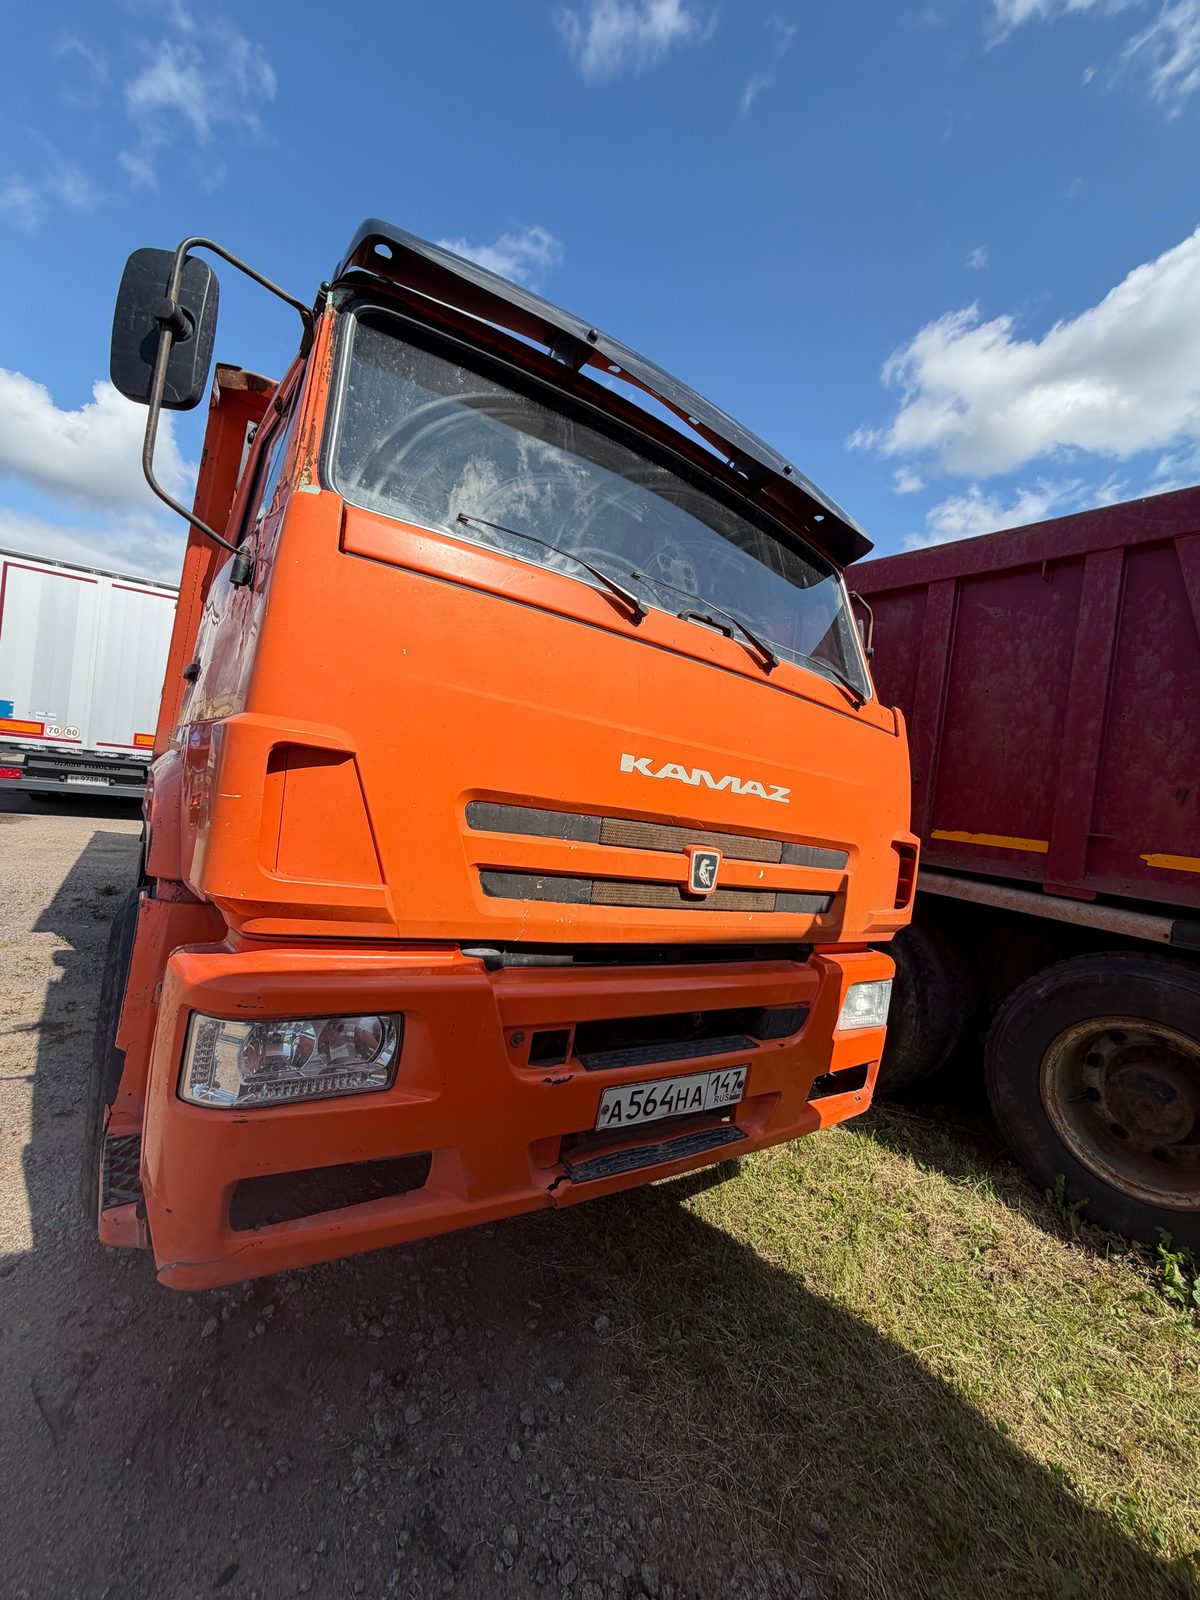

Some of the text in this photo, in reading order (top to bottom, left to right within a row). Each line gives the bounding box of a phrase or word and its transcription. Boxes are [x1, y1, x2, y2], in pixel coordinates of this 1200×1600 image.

[620, 753, 791, 803] KAMAZ
[711, 1070, 742, 1096] 147
[713, 1095, 729, 1104] RUS
